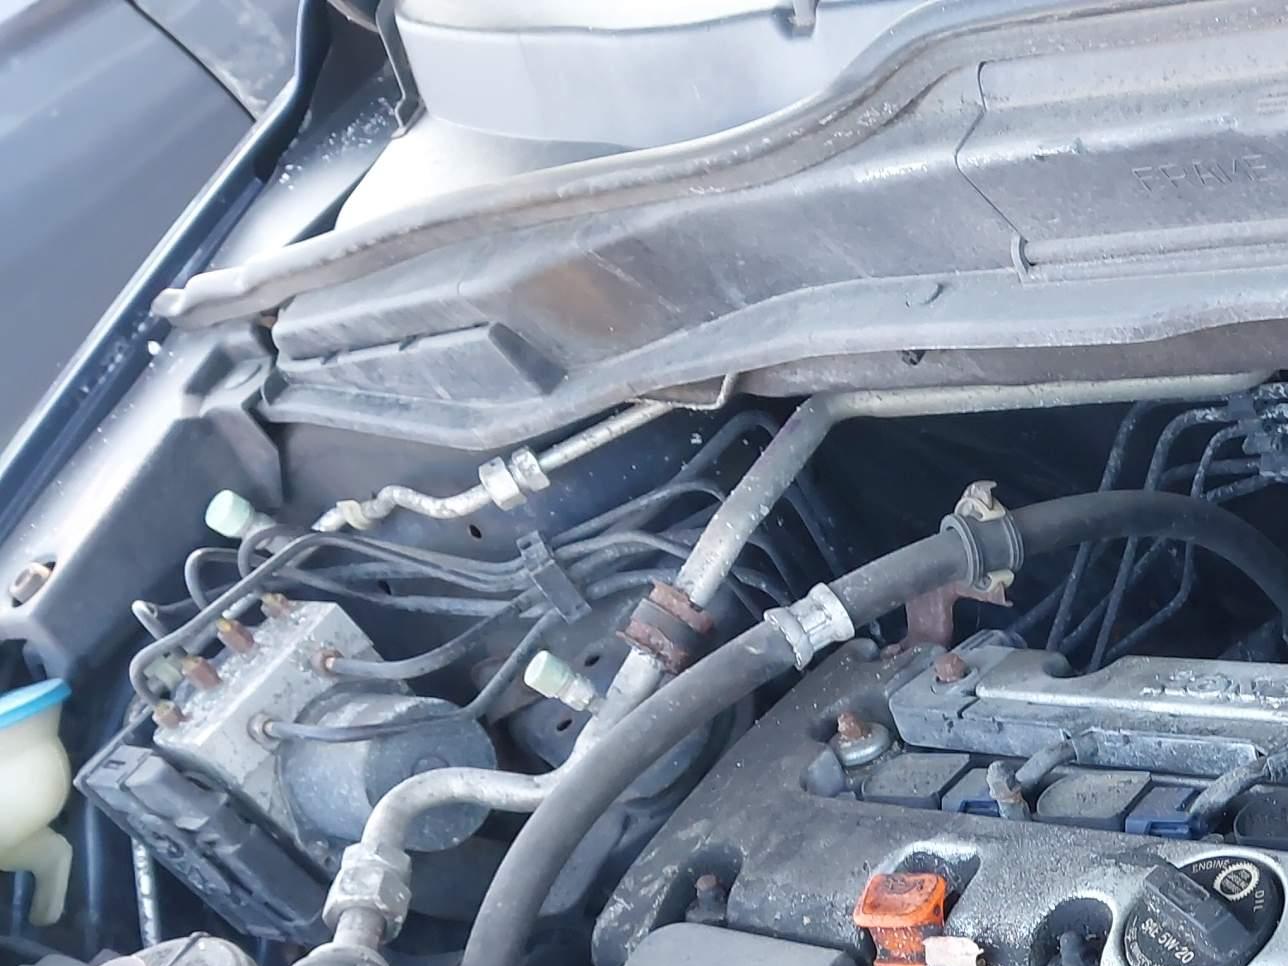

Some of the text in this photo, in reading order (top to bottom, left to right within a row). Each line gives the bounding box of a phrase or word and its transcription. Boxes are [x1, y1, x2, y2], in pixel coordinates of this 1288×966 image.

[1131, 154, 1277, 192] FRAME
[1192, 859, 1265, 913] ENGINE OIL
[1141, 917, 1195, 964] SAE 5W-20
